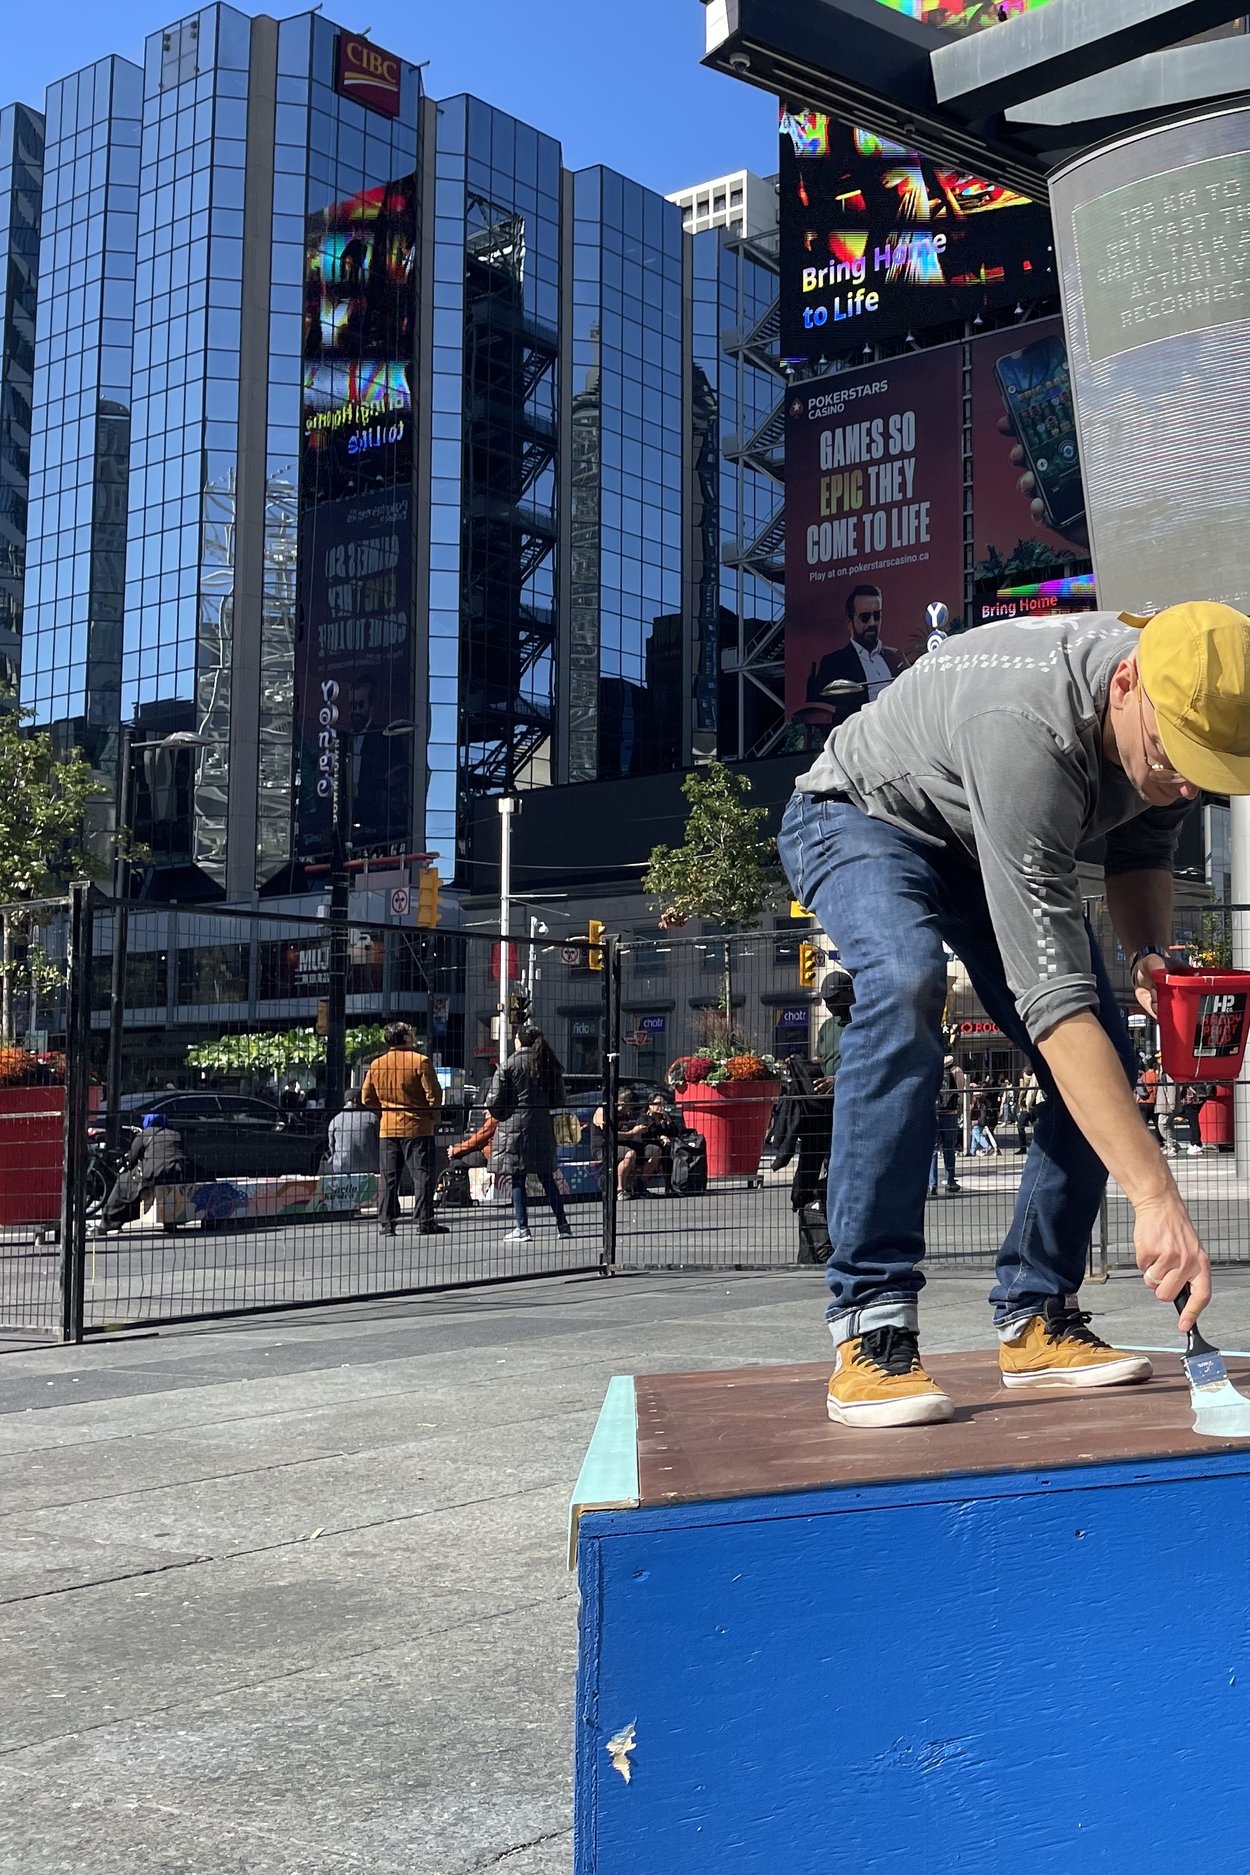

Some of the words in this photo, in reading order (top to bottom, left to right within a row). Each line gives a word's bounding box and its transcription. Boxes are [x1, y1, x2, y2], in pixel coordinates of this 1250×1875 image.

[346, 42, 397, 84] CIBC
[1205, 179, 1241, 200] TO
[803, 255, 866, 293] Bring
[874, 233, 947, 272] Home
[1172, 235, 1228, 264] TALK
[1130, 252, 1248, 299] ACTUALLY
[802, 305, 828, 329] to
[834, 288, 880, 321] Life
[808, 380, 889, 410] POKERSTARS
[808, 403, 845, 420] CASINO
[820, 418, 884, 471] GAMES
[889, 411, 916, 456] SO
[820, 469, 863, 517] EPIC
[868, 457, 916, 506] THEY
[806, 516, 858, 565] COME
[862, 510, 887, 554] TO
[892, 501, 931, 548] LIFE
[809, 572, 826, 582] Play
[827, 569, 835, 578] at
[982, 601, 1016, 618] Bring
[1020, 595, 1058, 611] Home
[643, 1018, 664, 1028] chatr
[784, 1010, 806, 1021] chatr
